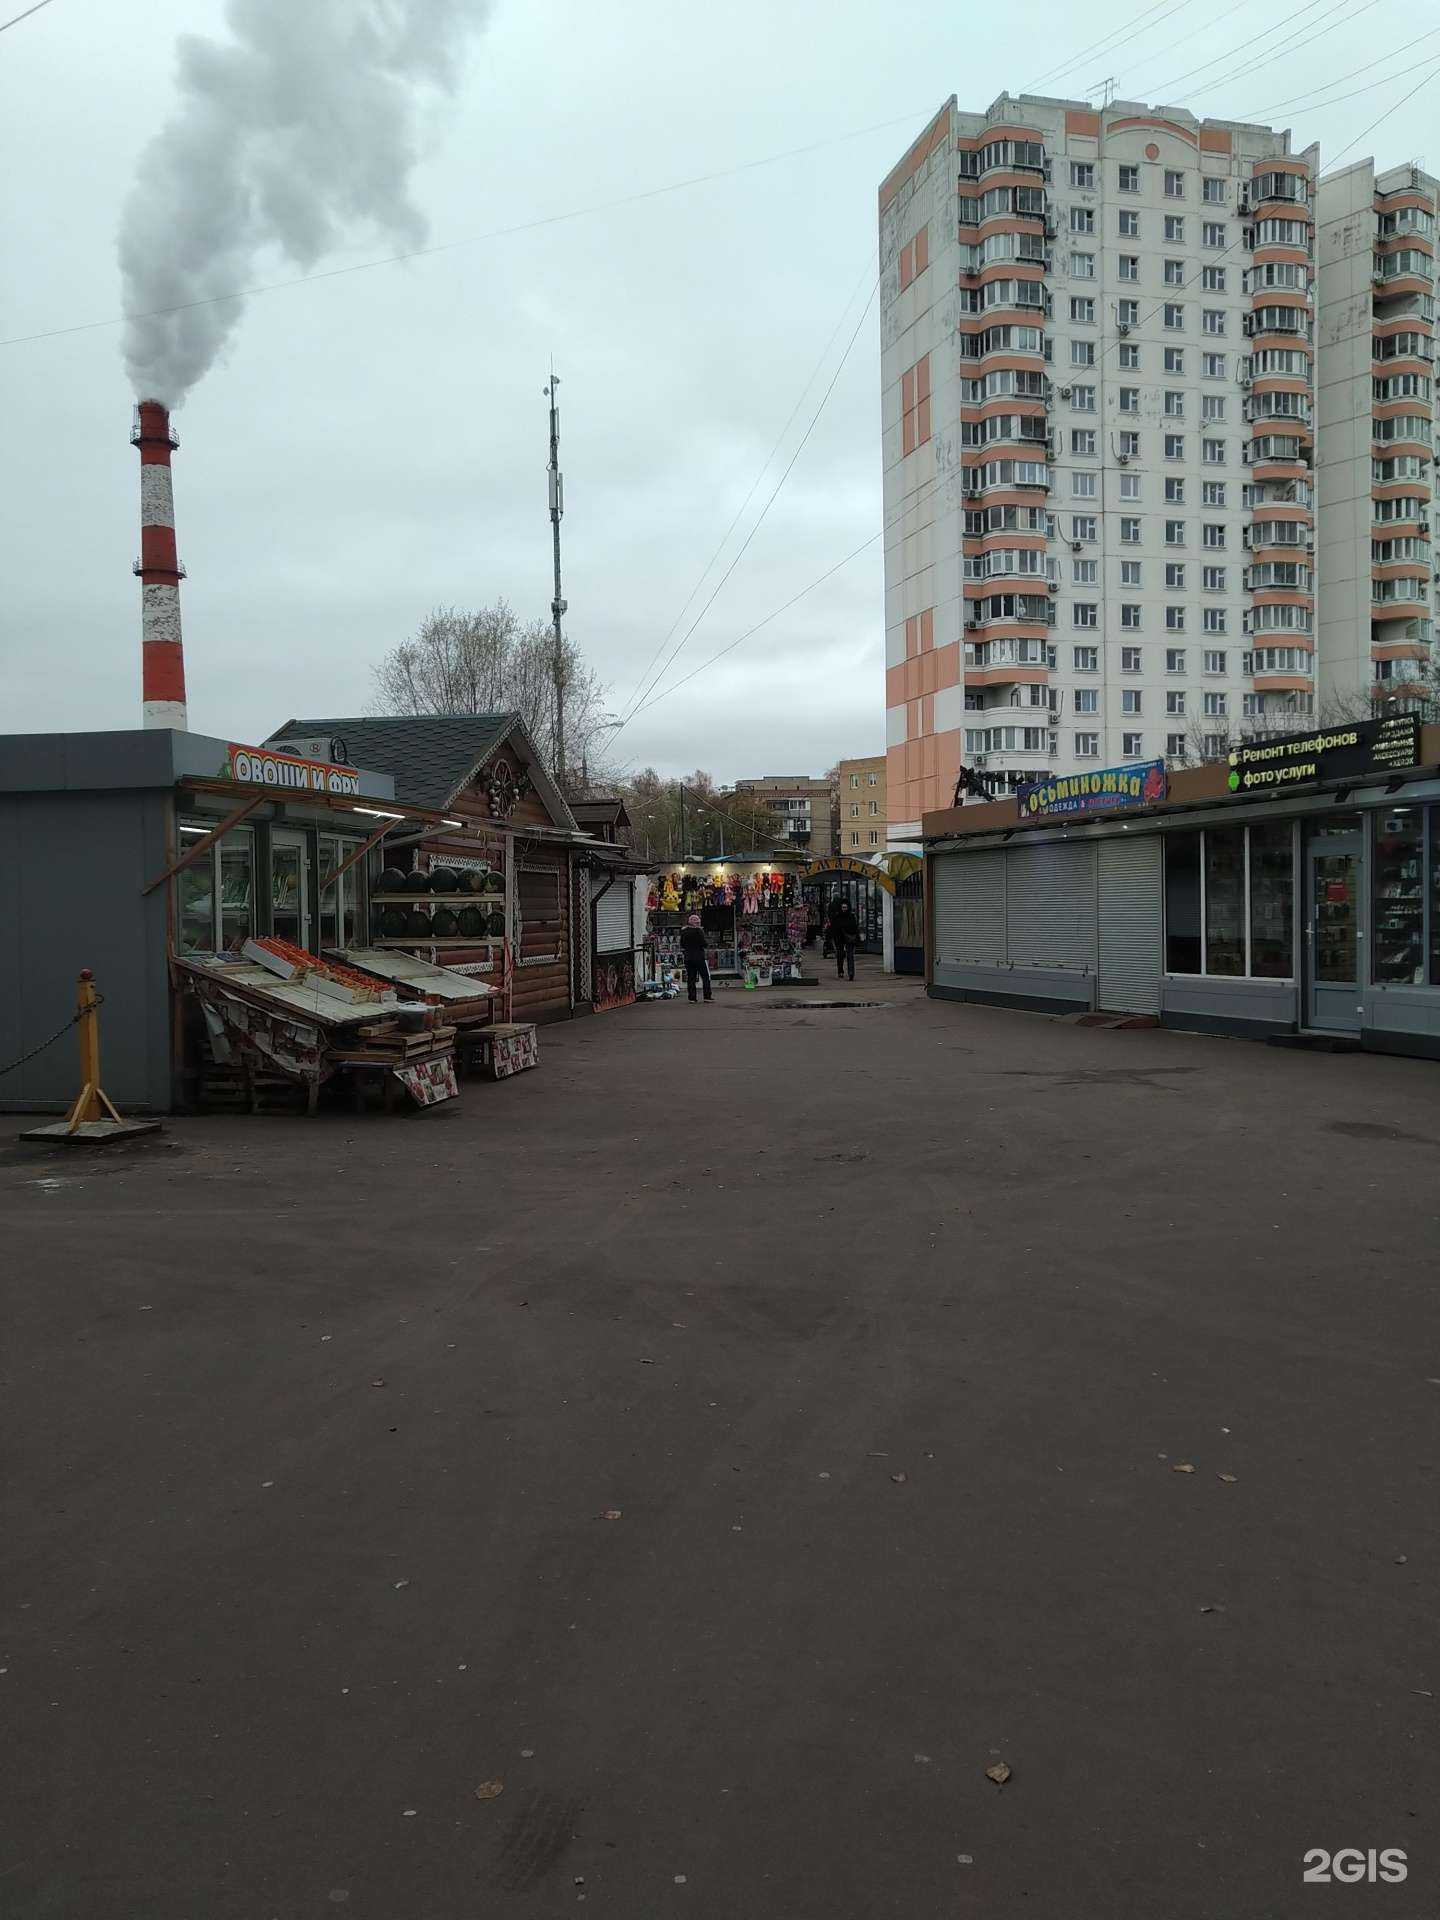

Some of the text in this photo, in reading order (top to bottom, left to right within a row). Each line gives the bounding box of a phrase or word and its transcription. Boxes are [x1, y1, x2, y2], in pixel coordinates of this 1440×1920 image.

[1243, 732, 1357, 763] Ремонт телефонов
[312, 769, 324, 791] И
[1244, 763, 1316, 788] фото услуги
